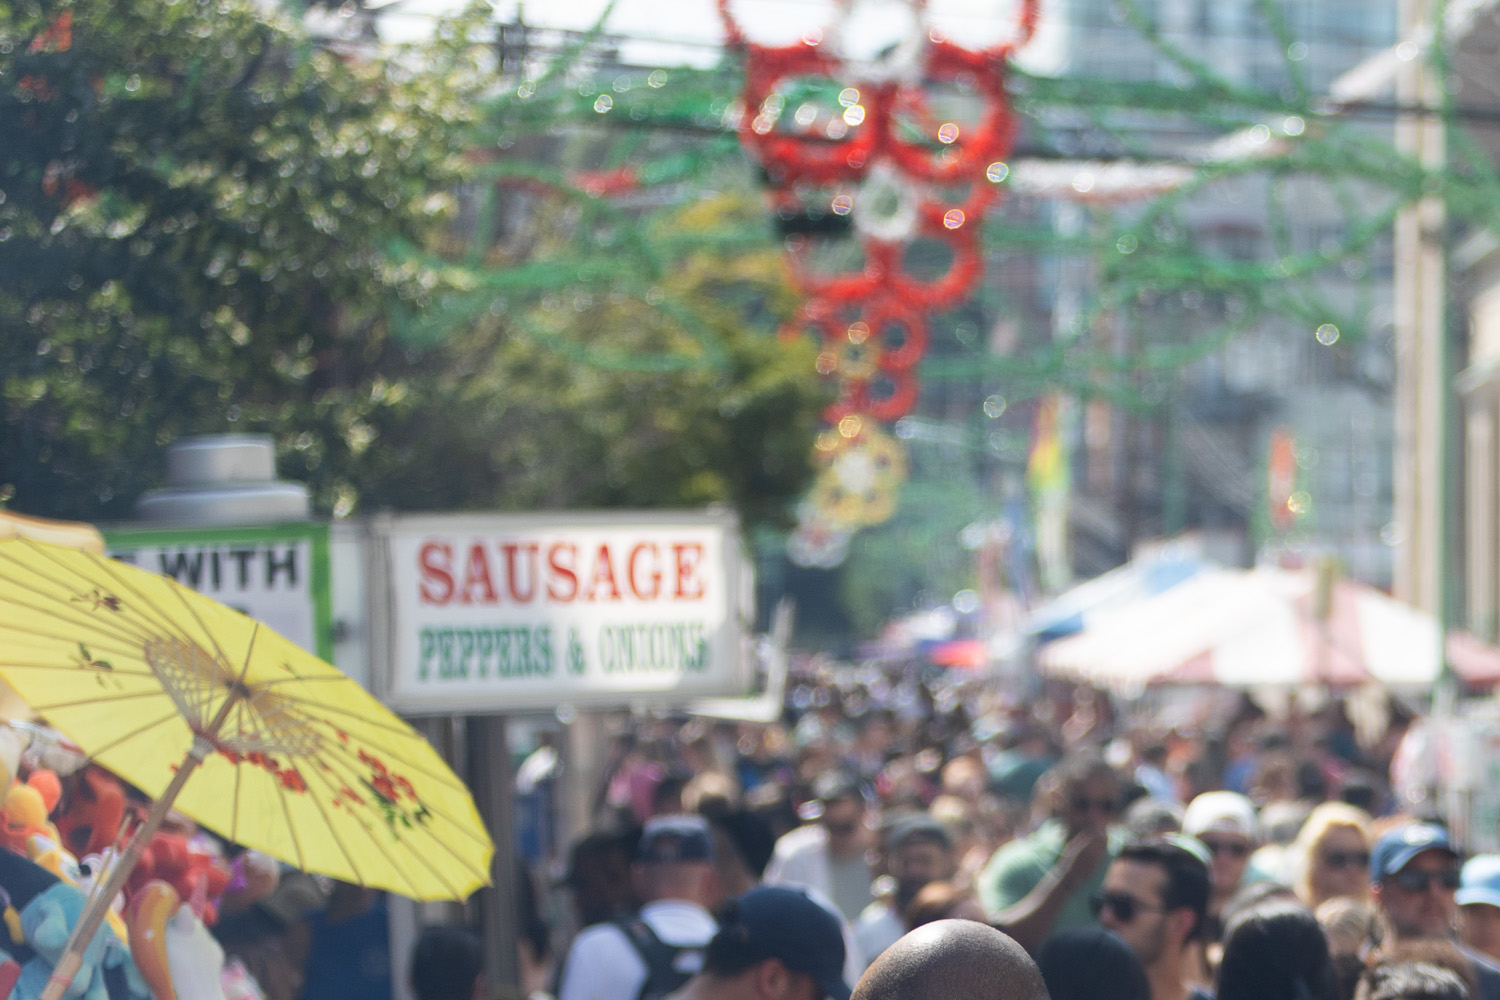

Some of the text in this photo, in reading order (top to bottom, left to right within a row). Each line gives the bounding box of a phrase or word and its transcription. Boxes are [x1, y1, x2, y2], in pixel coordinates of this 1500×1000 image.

[160, 547, 298, 589] WITH
[418, 540, 706, 604] SAUSAGE
[417, 622, 706, 679] PEPPERS & ONIONS
